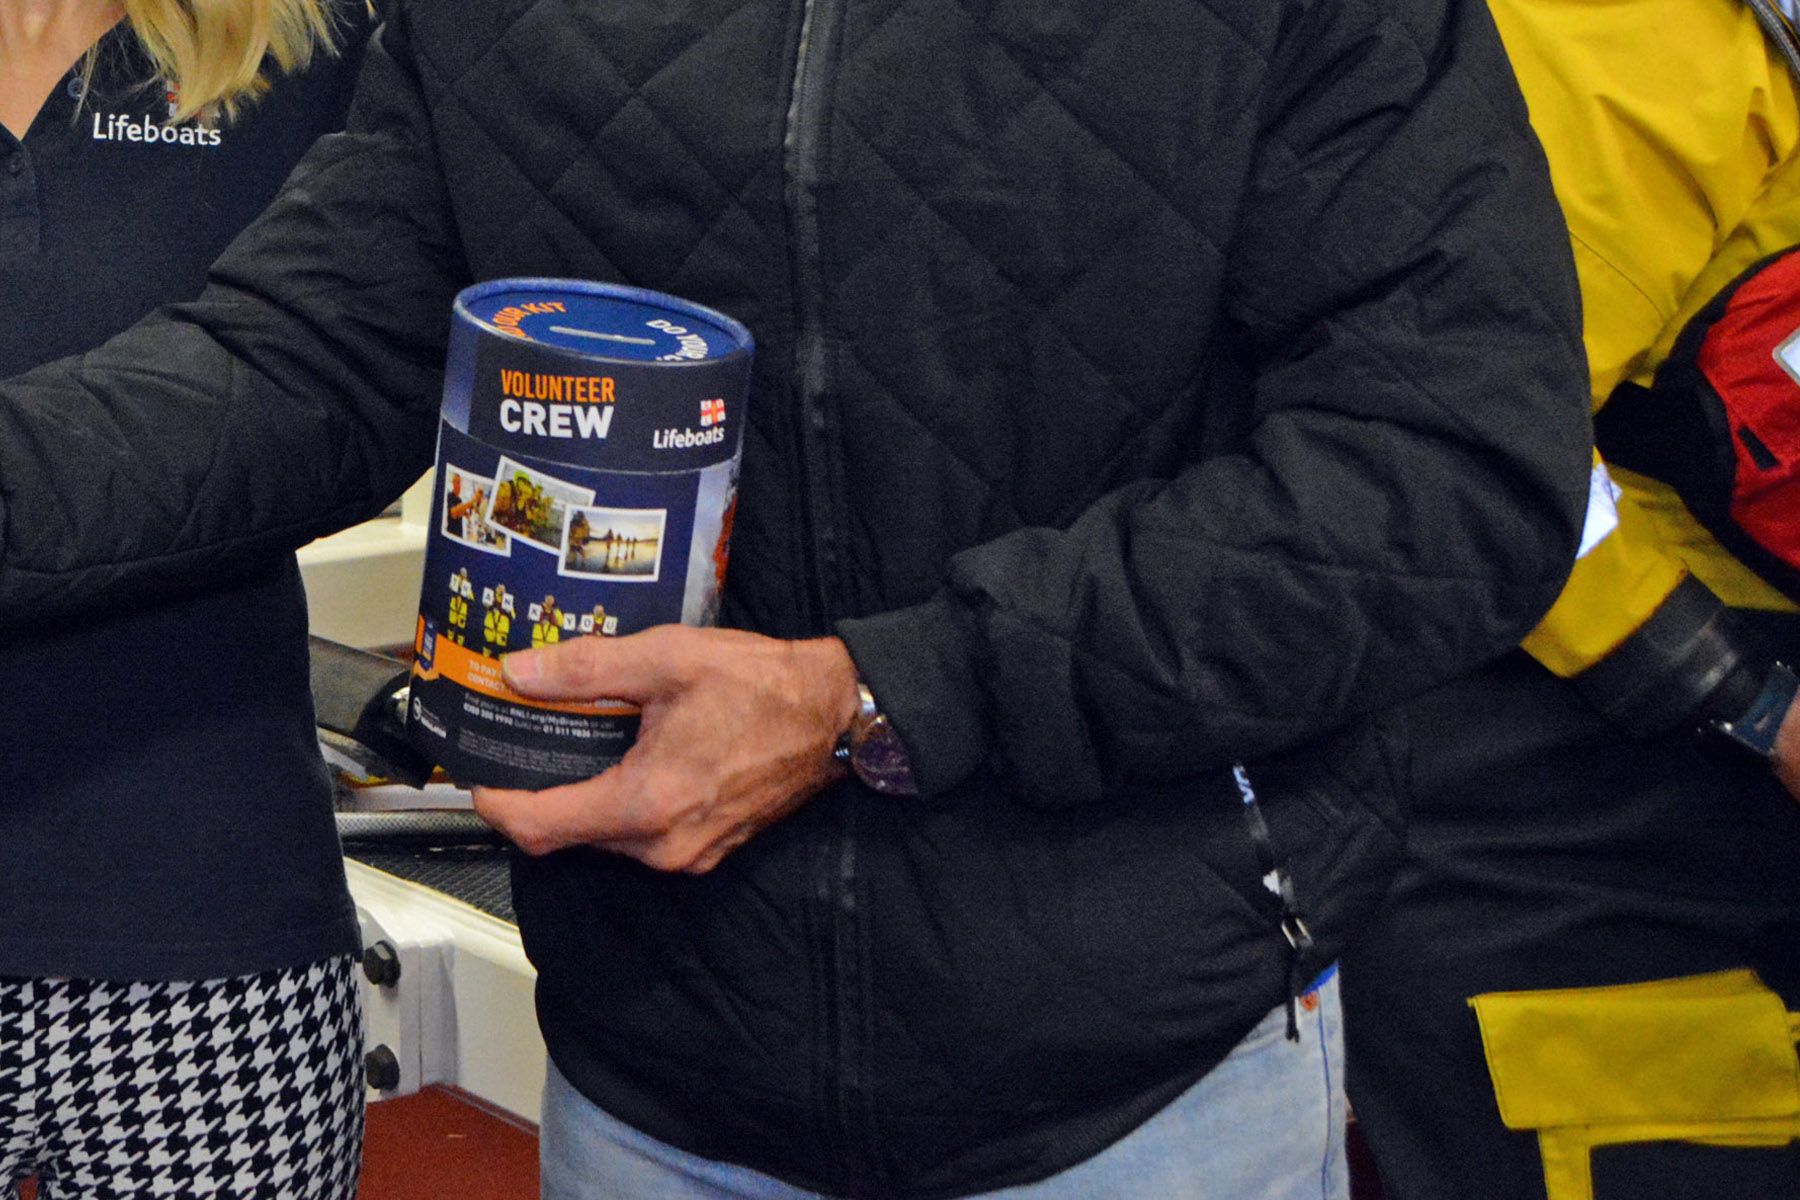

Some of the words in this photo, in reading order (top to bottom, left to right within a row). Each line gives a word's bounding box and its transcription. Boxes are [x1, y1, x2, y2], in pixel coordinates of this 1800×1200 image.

[93, 112, 221, 146] Lifeboats
[500, 368, 615, 403] VOLUNTEER
[500, 398, 615, 439] CREW
[653, 425, 725, 449] Lifeboats
